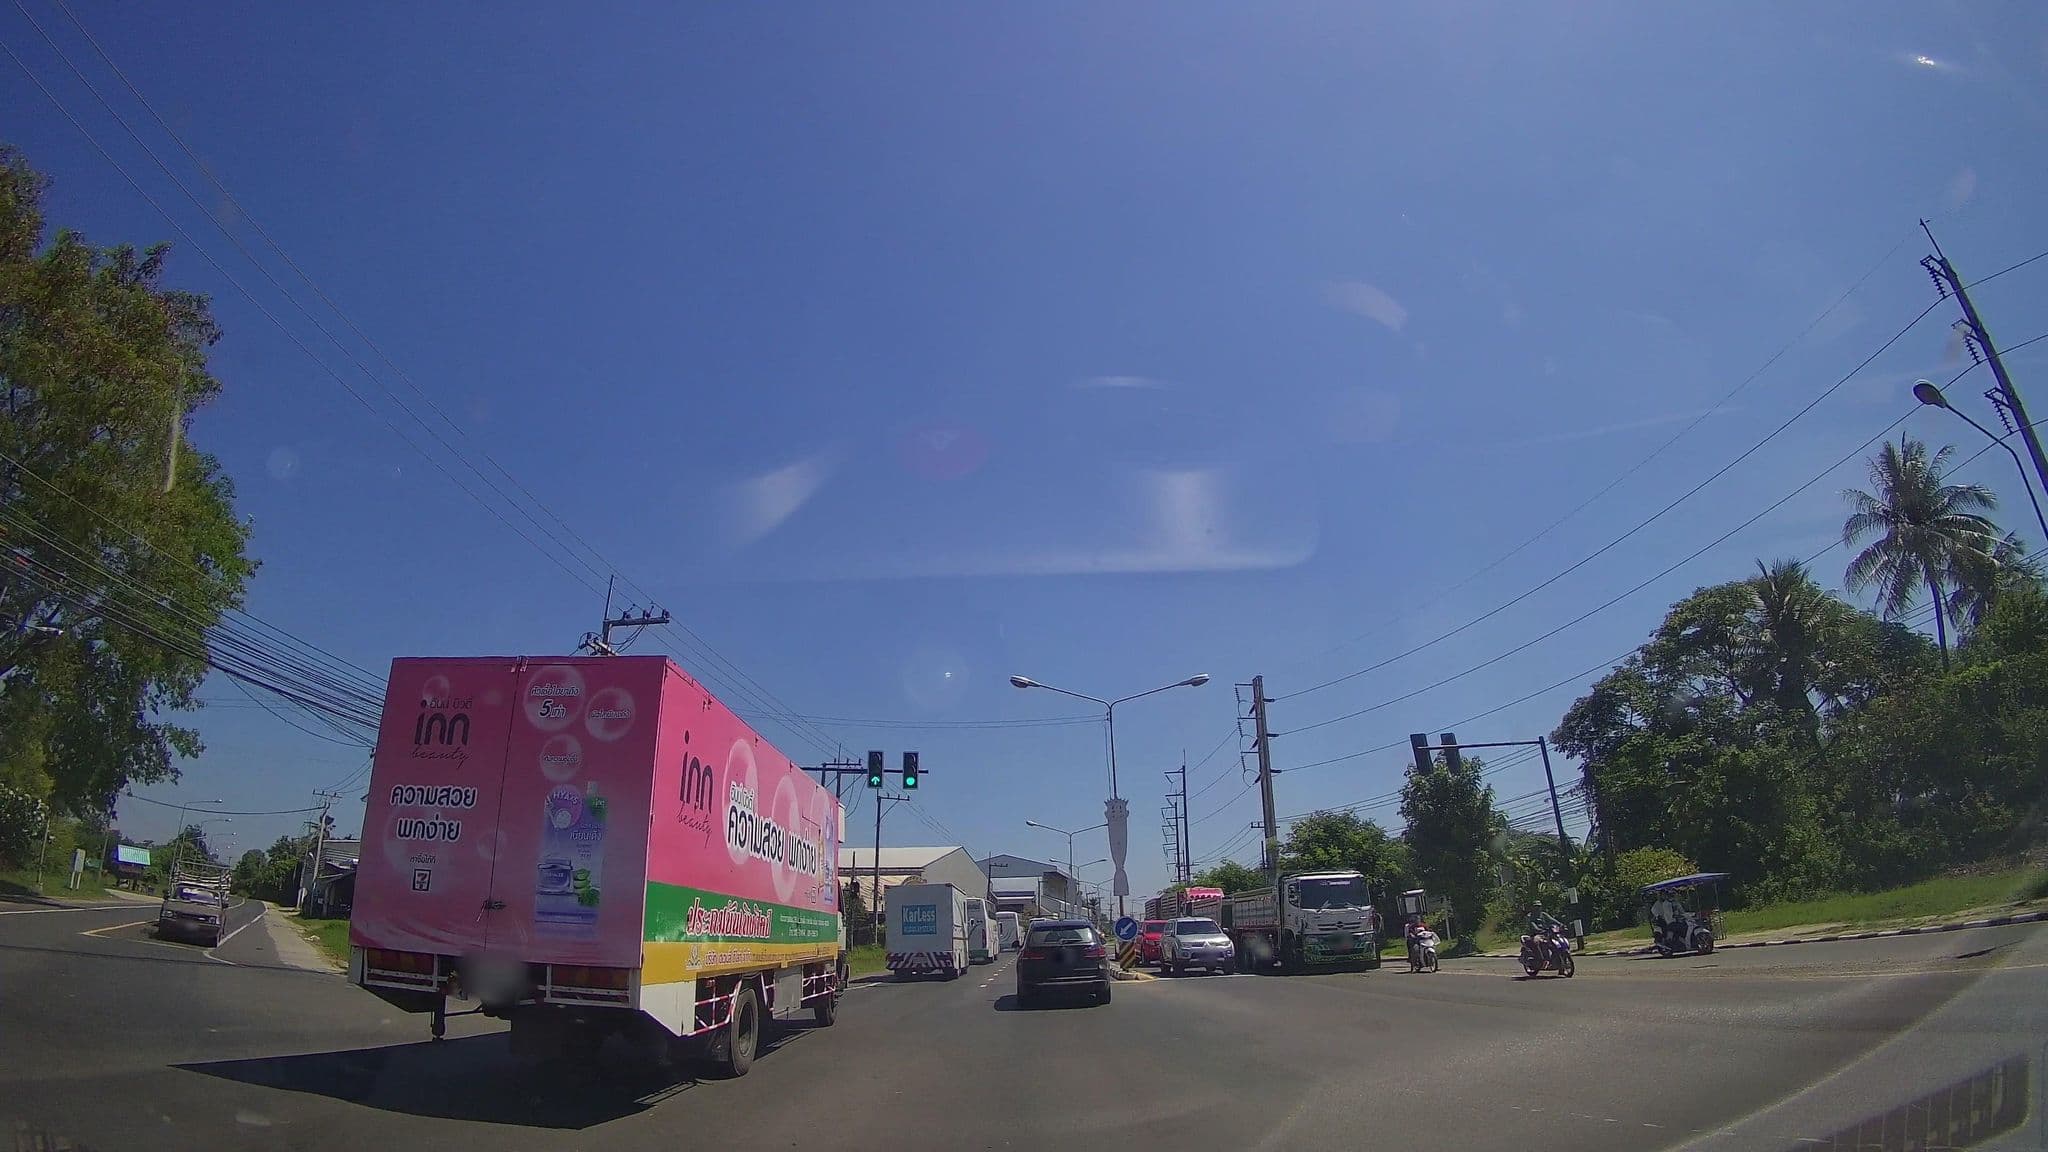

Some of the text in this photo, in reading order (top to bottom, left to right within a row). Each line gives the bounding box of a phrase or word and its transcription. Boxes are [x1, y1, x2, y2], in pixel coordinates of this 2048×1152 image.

[414, 699, 471, 747] inn
[412, 745, 472, 769] beauty
[680, 730, 713, 814] inn
[391, 785, 477, 808] ความสวย
[397, 813, 462, 841] พกง่าย
[728, 805, 817, 875] ความสวย พกง่าย
[902, 907, 936, 923] KarLess
